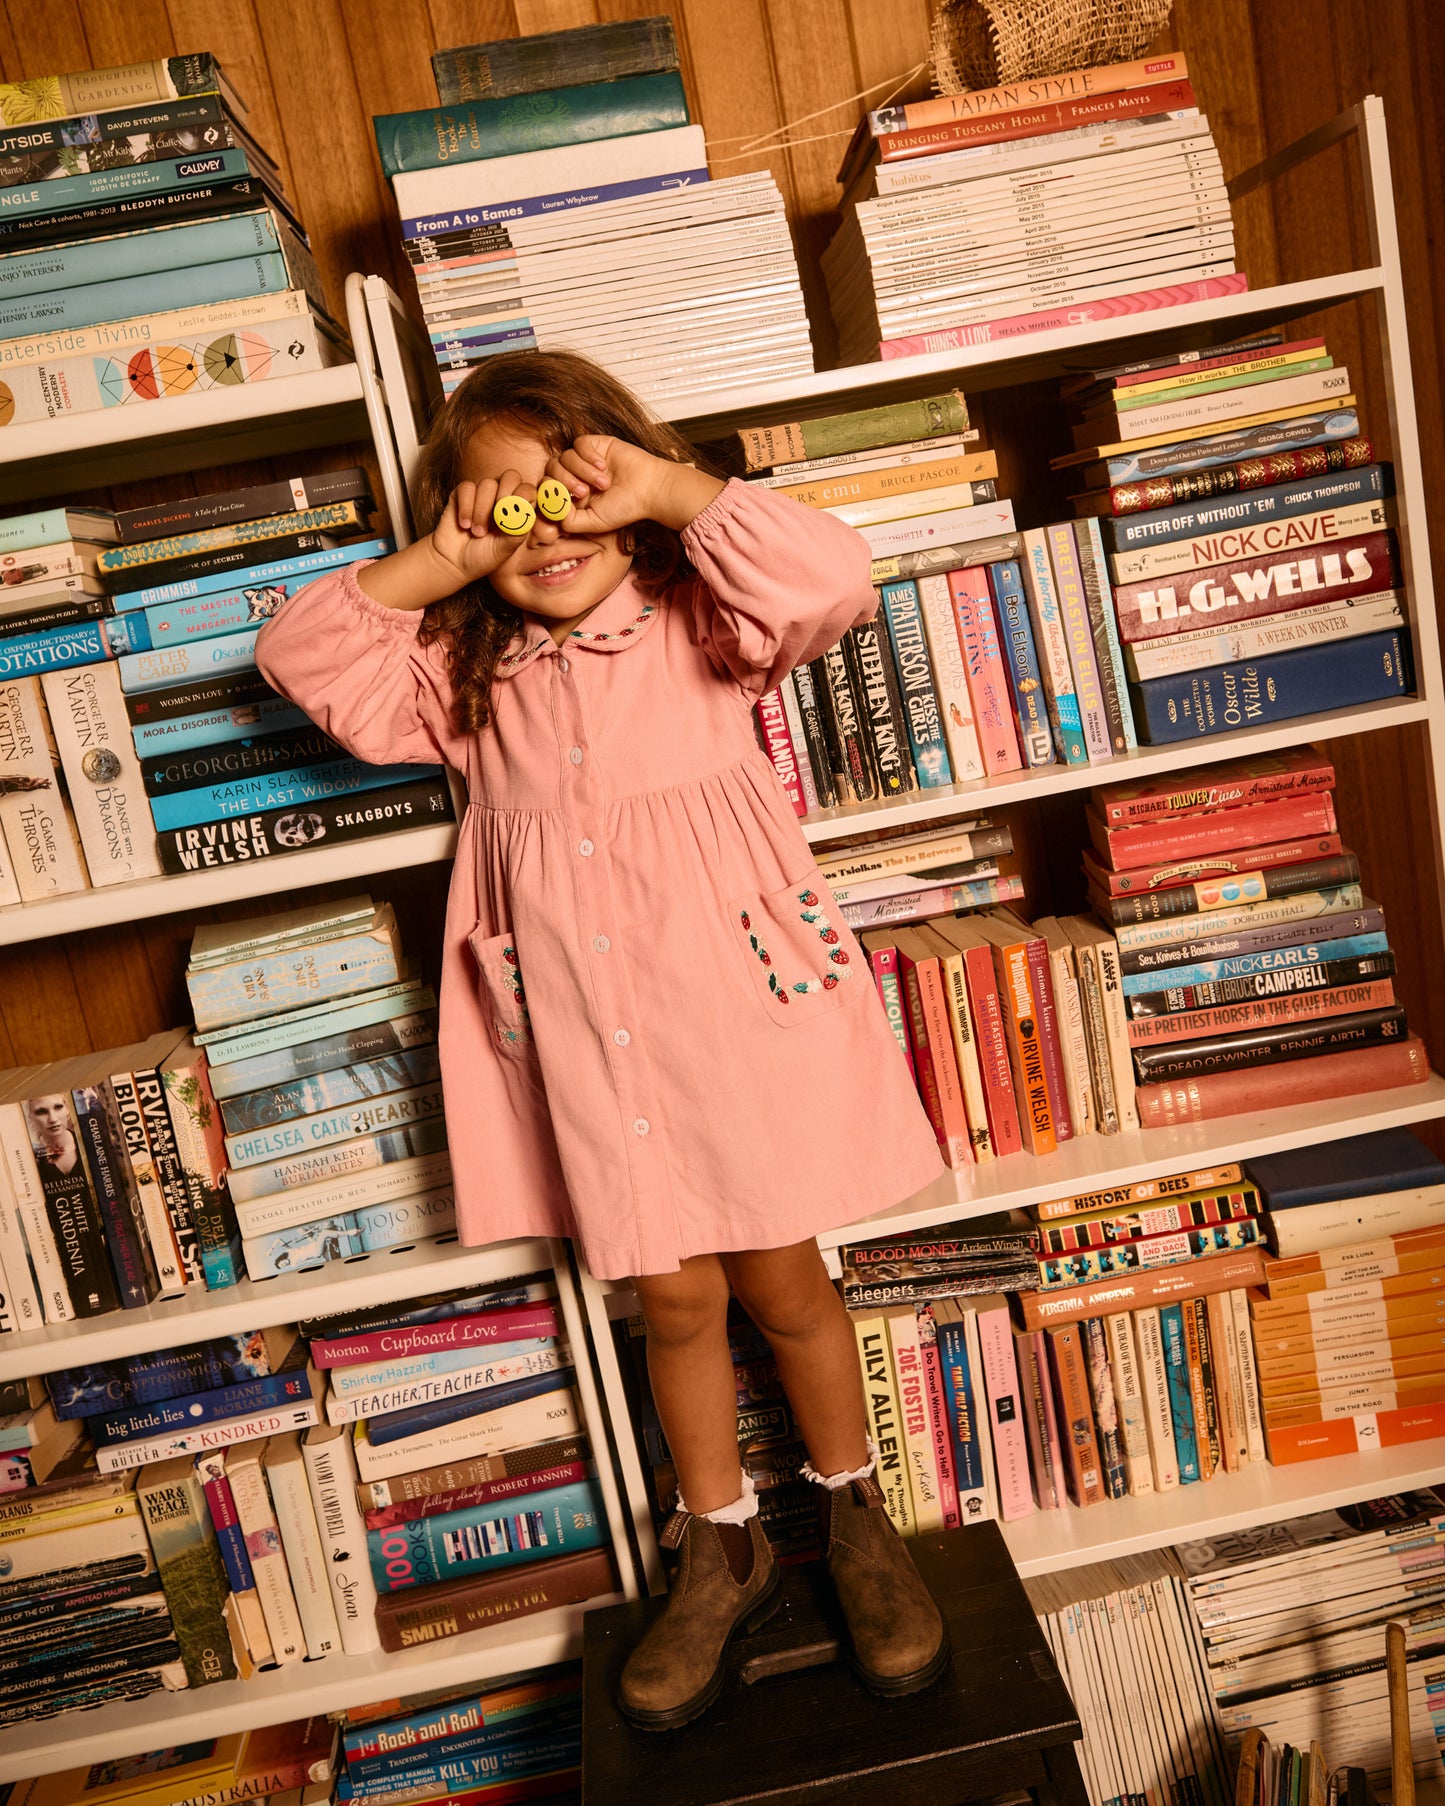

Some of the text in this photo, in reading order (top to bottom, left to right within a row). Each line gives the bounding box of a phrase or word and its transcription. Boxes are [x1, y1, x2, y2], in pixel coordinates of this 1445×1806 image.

[74, 66, 149, 86] THOUGHTFUL
[1147, 62, 1172, 72] TUTTLE
[77, 81, 153, 102] GARDENING
[951, 74, 1094, 118] JAPAN STYLE
[1071, 95, 1150, 116] FRANCES MAYES
[107, 114, 169, 131] DAVID STEVENS
[888, 113, 1047, 150] BRINGING TUSCANY HOME
[179, 159, 221, 176] CALLWEY
[121, 189, 212, 212] BLEDDYN BUTCHER
[542, 193, 599, 209] Lauren Whybrow
[416, 217, 450, 233] From
[452, 214, 462, 227] A
[482, 205, 523, 224] Eames
[433, 312, 451, 321] belle
[922, 331, 959, 353] THINGS
[968, 325, 992, 344] LOVE
[1179, 376, 1195, 384] How
[1232, 365, 1247, 374] THE
[1250, 356, 1286, 371] BROTHER
[1323, 376, 1346, 390] PICADOR
[50, 374, 64, 409] MODERN
[58, 371, 72, 409] COMPLETE
[1258, 426, 1312, 443] GEORGE ORWELL
[881, 466, 961, 488] BRUCE PASCOE
[822, 483, 861, 500] emu
[1284, 480, 1360, 504] CHUCK THOMPSON
[133, 512, 191, 528] CHARLES DICKENS
[1127, 521, 1171, 540] BETTER
[1172, 515, 1194, 530] OFF
[1197, 504, 1250, 525] WITHOUT
[1192, 514, 1338, 565] NICK CAVE
[250, 552, 344, 578] MICHAEL WINKLER
[141, 580, 198, 603] GRIMMISH
[889, 588, 914, 606] JAMES
[1054, 531, 1098, 710] BRET EASTON ELLIS
[891, 597, 931, 691] PATTERSON
[1005, 594, 1031, 677] Ben Elton
[160, 688, 223, 709] WOMEN IN LOVE
[1224, 672, 1240, 725] Oscar
[1247, 667, 1264, 720] Wilde
[909, 696, 928, 745] GIRLS
[922, 694, 940, 740] KISS THE
[759, 694, 797, 790] WETLANDS
[218, 777, 361, 814] THE LAST WIDOW
[335, 802, 412, 828] SKAGBOYS
[174, 817, 265, 852] IRVINE
[179, 838, 269, 870] WELSH
[1234, 906, 1306, 925] DOROTHY HALL
[1009, 950, 1031, 1019] Trainspotting
[1225, 967, 1326, 1000] BRUCE CAMPBELL
[1023, 1040, 1050, 1133] IRVINE WELSH
[115, 1083, 148, 1156] BLOCK
[234, 1116, 351, 1160] CHELSEA CAIN
[274, 1147, 365, 1178] HANNAH KENT
[1045, 1200, 1071, 1215] THE
[1136, 1183, 1156, 1197] OF
[71, 1194, 89, 1233] WHITE
[56, 1197, 85, 1276] GARDENIA
[855, 1242, 959, 1264] BLOOD MONEY
[852, 1283, 915, 1301] sleepers
[1037, 1287, 1135, 1316] VIRGINIA ANDREWS
[380, 1324, 498, 1356] Cupboard Love
[926, 1352, 932, 1365] Do
[1333, 1350, 1374, 1360] PERSUASION
[341, 1359, 436, 1390] Shirley Hazzard
[928, 1366, 936, 1392] Travel
[862, 1334, 900, 1471] LILY ALLEN
[898, 1346, 926, 1436] ZOË FOSTER
[932, 1396, 942, 1428] Writers
[1348, 1403, 1362, 1411] THE
[1364, 1400, 1382, 1409] ROAD
[106, 1409, 184, 1436] big little lies
[200, 1417, 280, 1447] KINDRED
[936, 1431, 943, 1444] Go
[490, 1468, 572, 1494] ROBERT FANNIN
[940, 1457, 950, 1478] Hell?
[146, 1490, 173, 1506] WAR
[148, 1500, 189, 1518] PEACE
[886, 1488, 896, 1518] Exactly
[897, 1488, 908, 1526] Thoughts
[380, 1524, 415, 1590] 1001
[409, 1520, 434, 1586] BOOKS
[336, 1573, 357, 1620] Swan
[400, 1618, 458, 1646] SMITH
[101, 1658, 128, 1671] MAUPIN
[205, 1669, 222, 1680] Pan
[377, 1707, 479, 1752] Rock and Roll
[440, 1755, 499, 1780] KILL YOU
